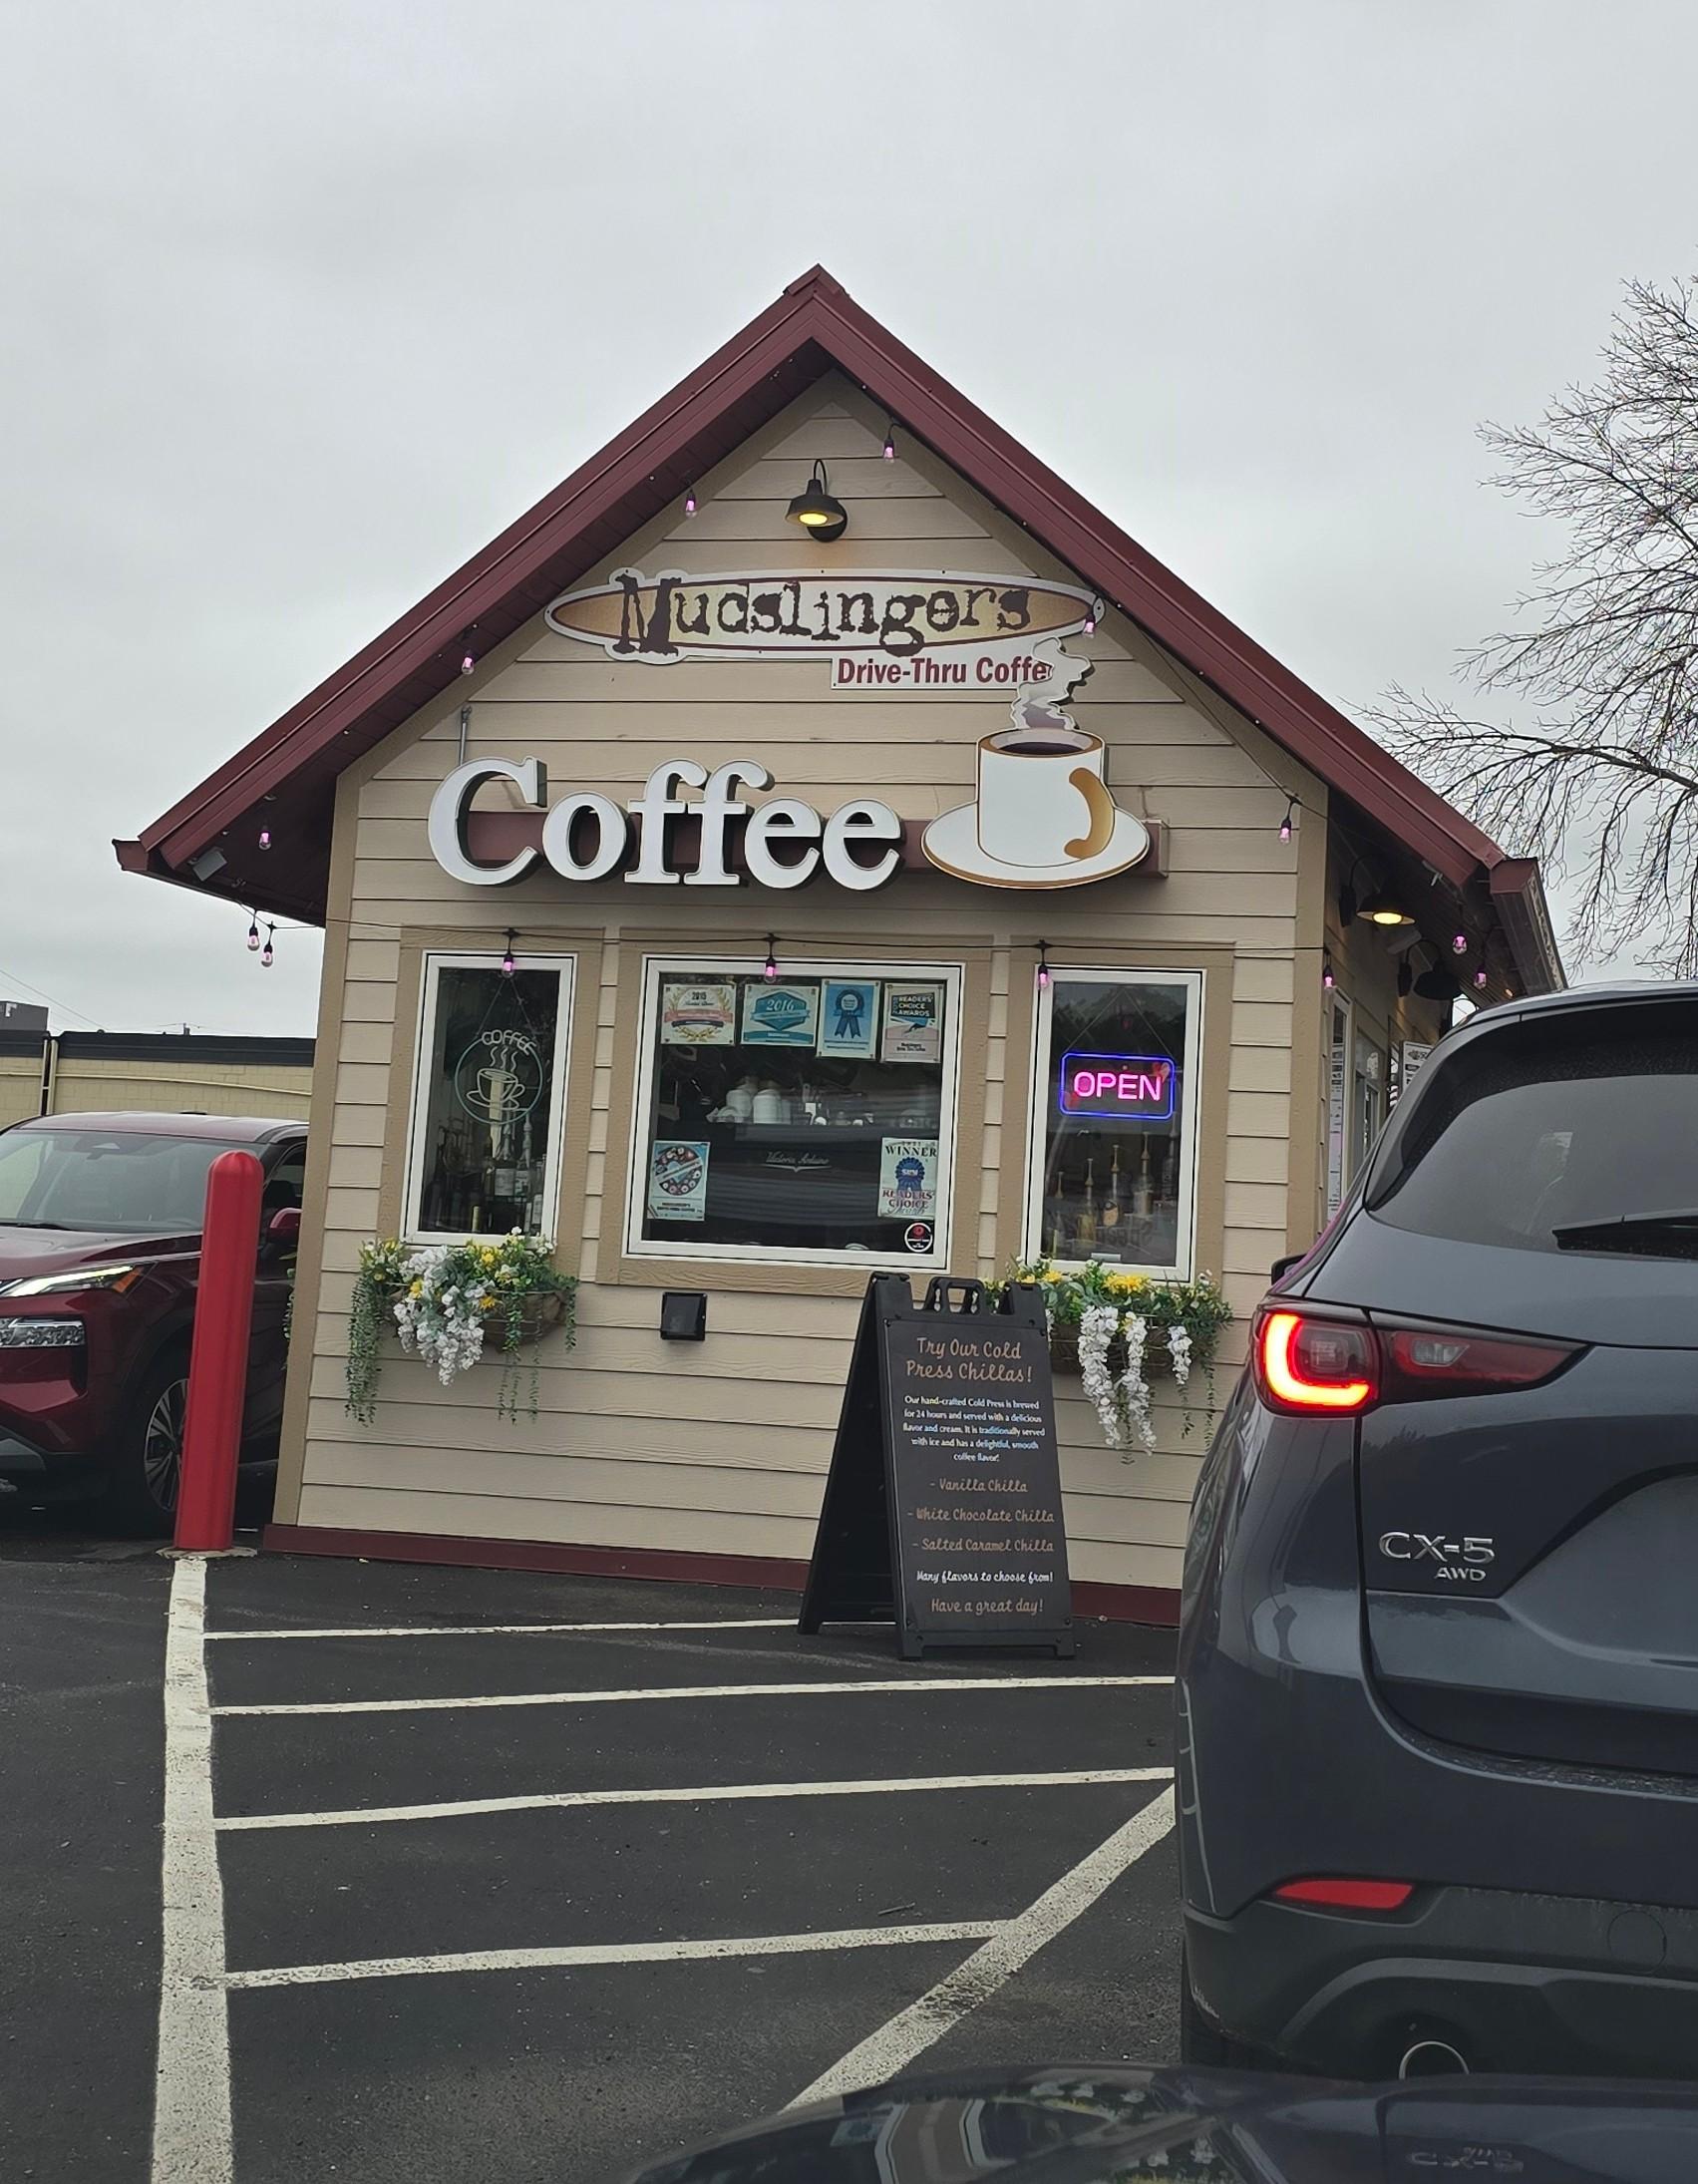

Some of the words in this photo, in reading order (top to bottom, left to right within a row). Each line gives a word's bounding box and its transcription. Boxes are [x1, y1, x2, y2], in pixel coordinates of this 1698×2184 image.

[838, 657, 967, 684] Drive-Thru
[976, 655, 1053, 683] Coffe
[428, 755, 902, 891] Coffee
[767, 998, 795, 1011] 2016
[482, 1029, 536, 1055] COFFEE
[1074, 1071, 1162, 1101] OPEN
[885, 1145, 937, 1157] WINNER
[888, 1199, 928, 1210] CHOICE
[917, 1337, 945, 1359] Try
[950, 1339, 978, 1356] Our
[984, 1342, 1021, 1358] Cold
[907, 1360, 952, 1379] Press
[959, 1362, 1032, 1382] Chillas!
[921, 1396, 966, 1406] hand-crafted
[968, 1398, 985, 1407] Cold
[1013, 1400, 1039, 1409] brewed
[926, 1410, 946, 1419] hours
[979, 1426, 1020, 1437] traditionally
[939, 1478, 986, 1491] Vanilla
[988, 1480, 1028, 1492] Chilla
[916, 1507, 950, 1521] White
[953, 1508, 1012, 1522] Chocolate
[1015, 1510, 1054, 1522] Chilla
[922, 1538, 962, 1551] Salted
[965, 1539, 1012, 1552] Caramel
[1015, 1540, 1054, 1552] Chilla
[1379, 1531, 1496, 1564] CX-5
[942, 1571, 978, 1583] flavors
[980, 1571, 992, 1582] to
[994, 1571, 1026, 1582] choose
[1028, 1571, 1053, 1584] from!
[1435, 1567, 1487, 1582] AWD
[931, 1599, 962, 1613] Have
[965, 1604, 973, 1613] a
[976, 1599, 1013, 1616] great
[1016, 1599, 1043, 1616] day!
